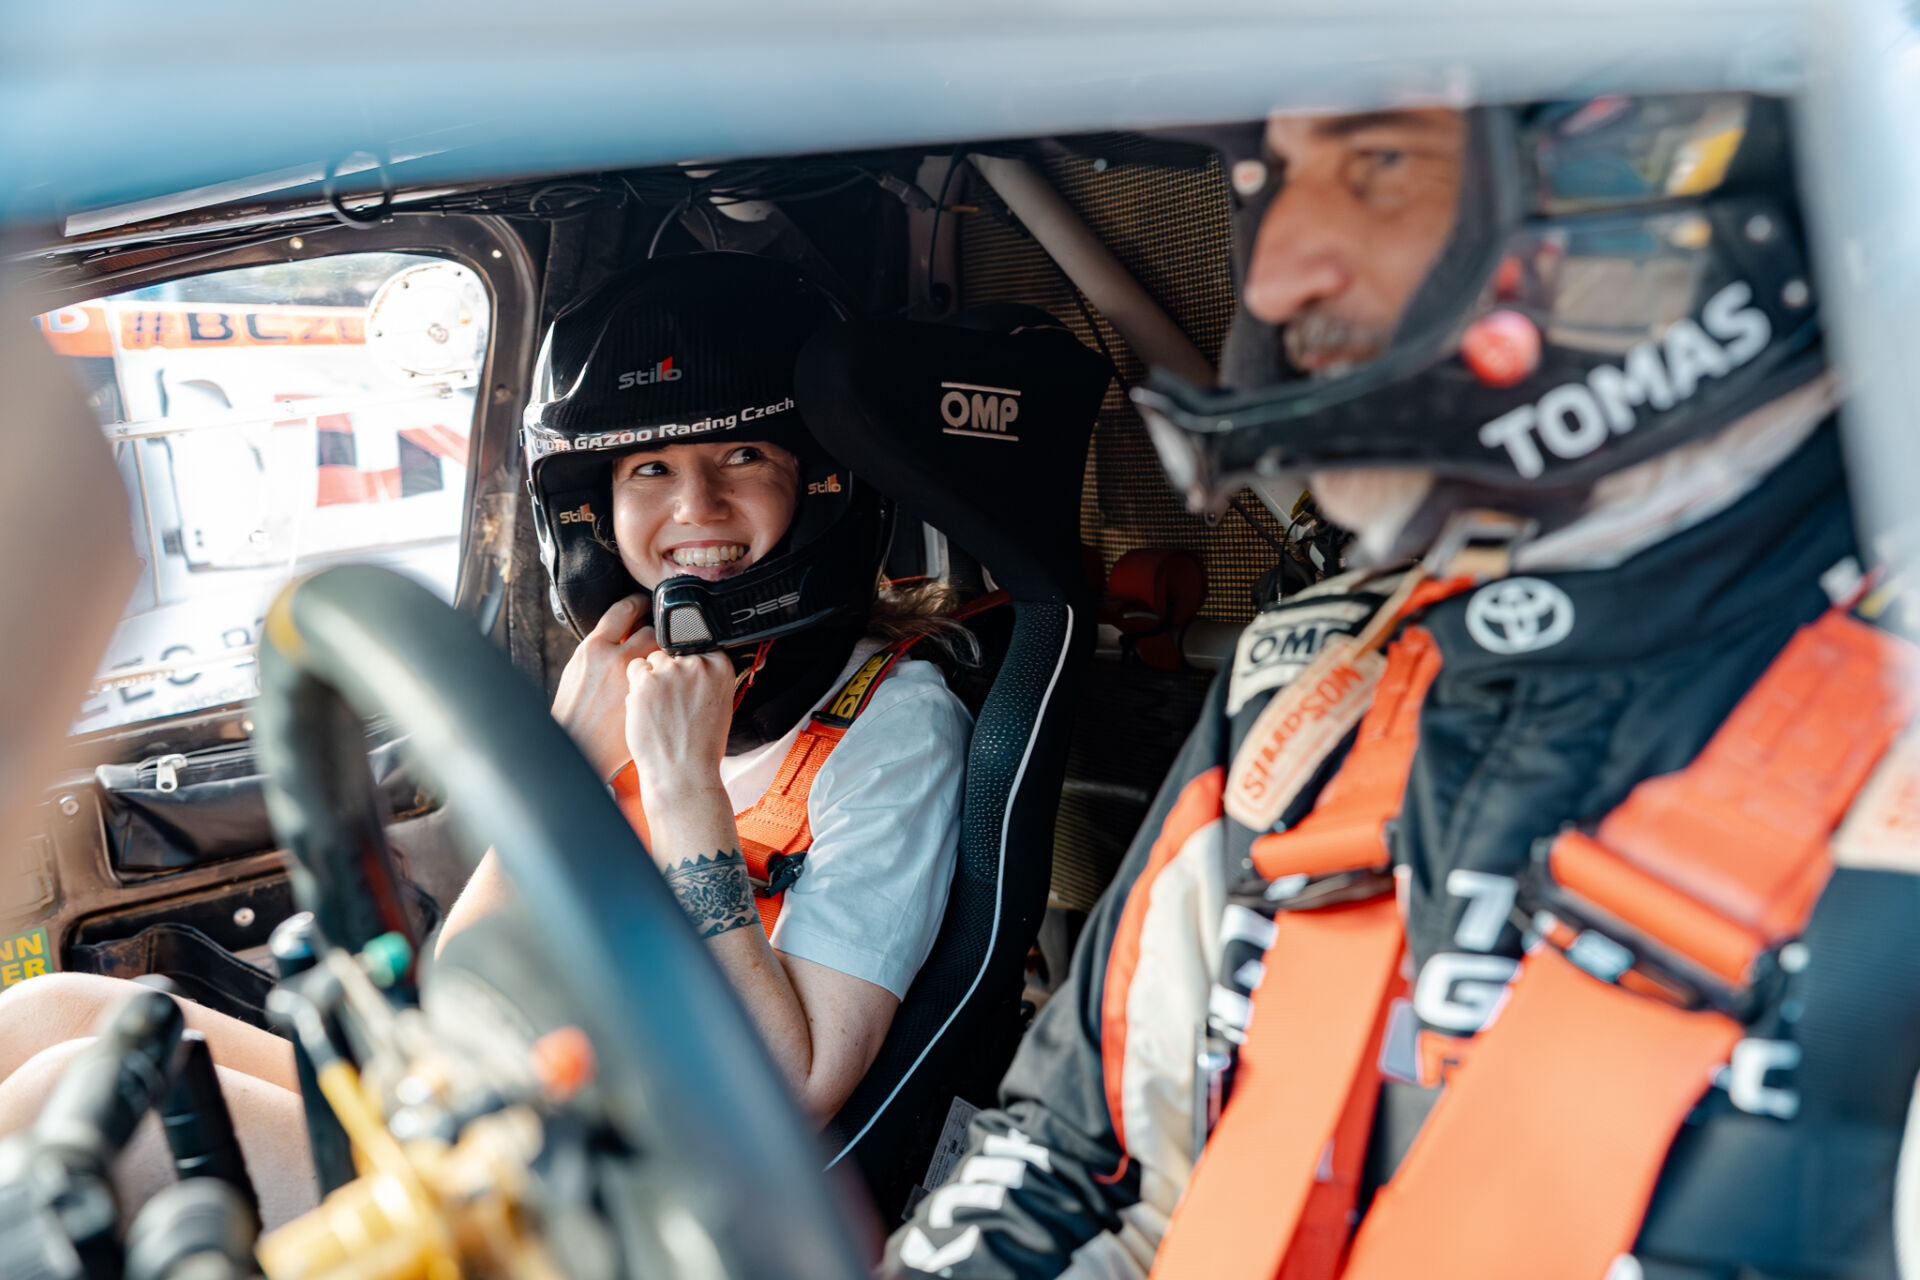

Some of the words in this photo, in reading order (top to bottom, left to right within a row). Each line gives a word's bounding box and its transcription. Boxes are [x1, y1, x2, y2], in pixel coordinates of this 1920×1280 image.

[618, 356, 682, 390] Stilo
[1478, 288, 1772, 479] TOMAS
[574, 429, 652, 450] GAZOO
[659, 415, 737, 438] Racing
[741, 397, 795, 422] Czech
[941, 391, 1019, 432] OMP
[808, 473, 841, 494] Stilo
[559, 503, 596, 524] Stilo
[837, 655, 884, 719] OMP
[1243, 664, 1364, 799] SIMPSON
